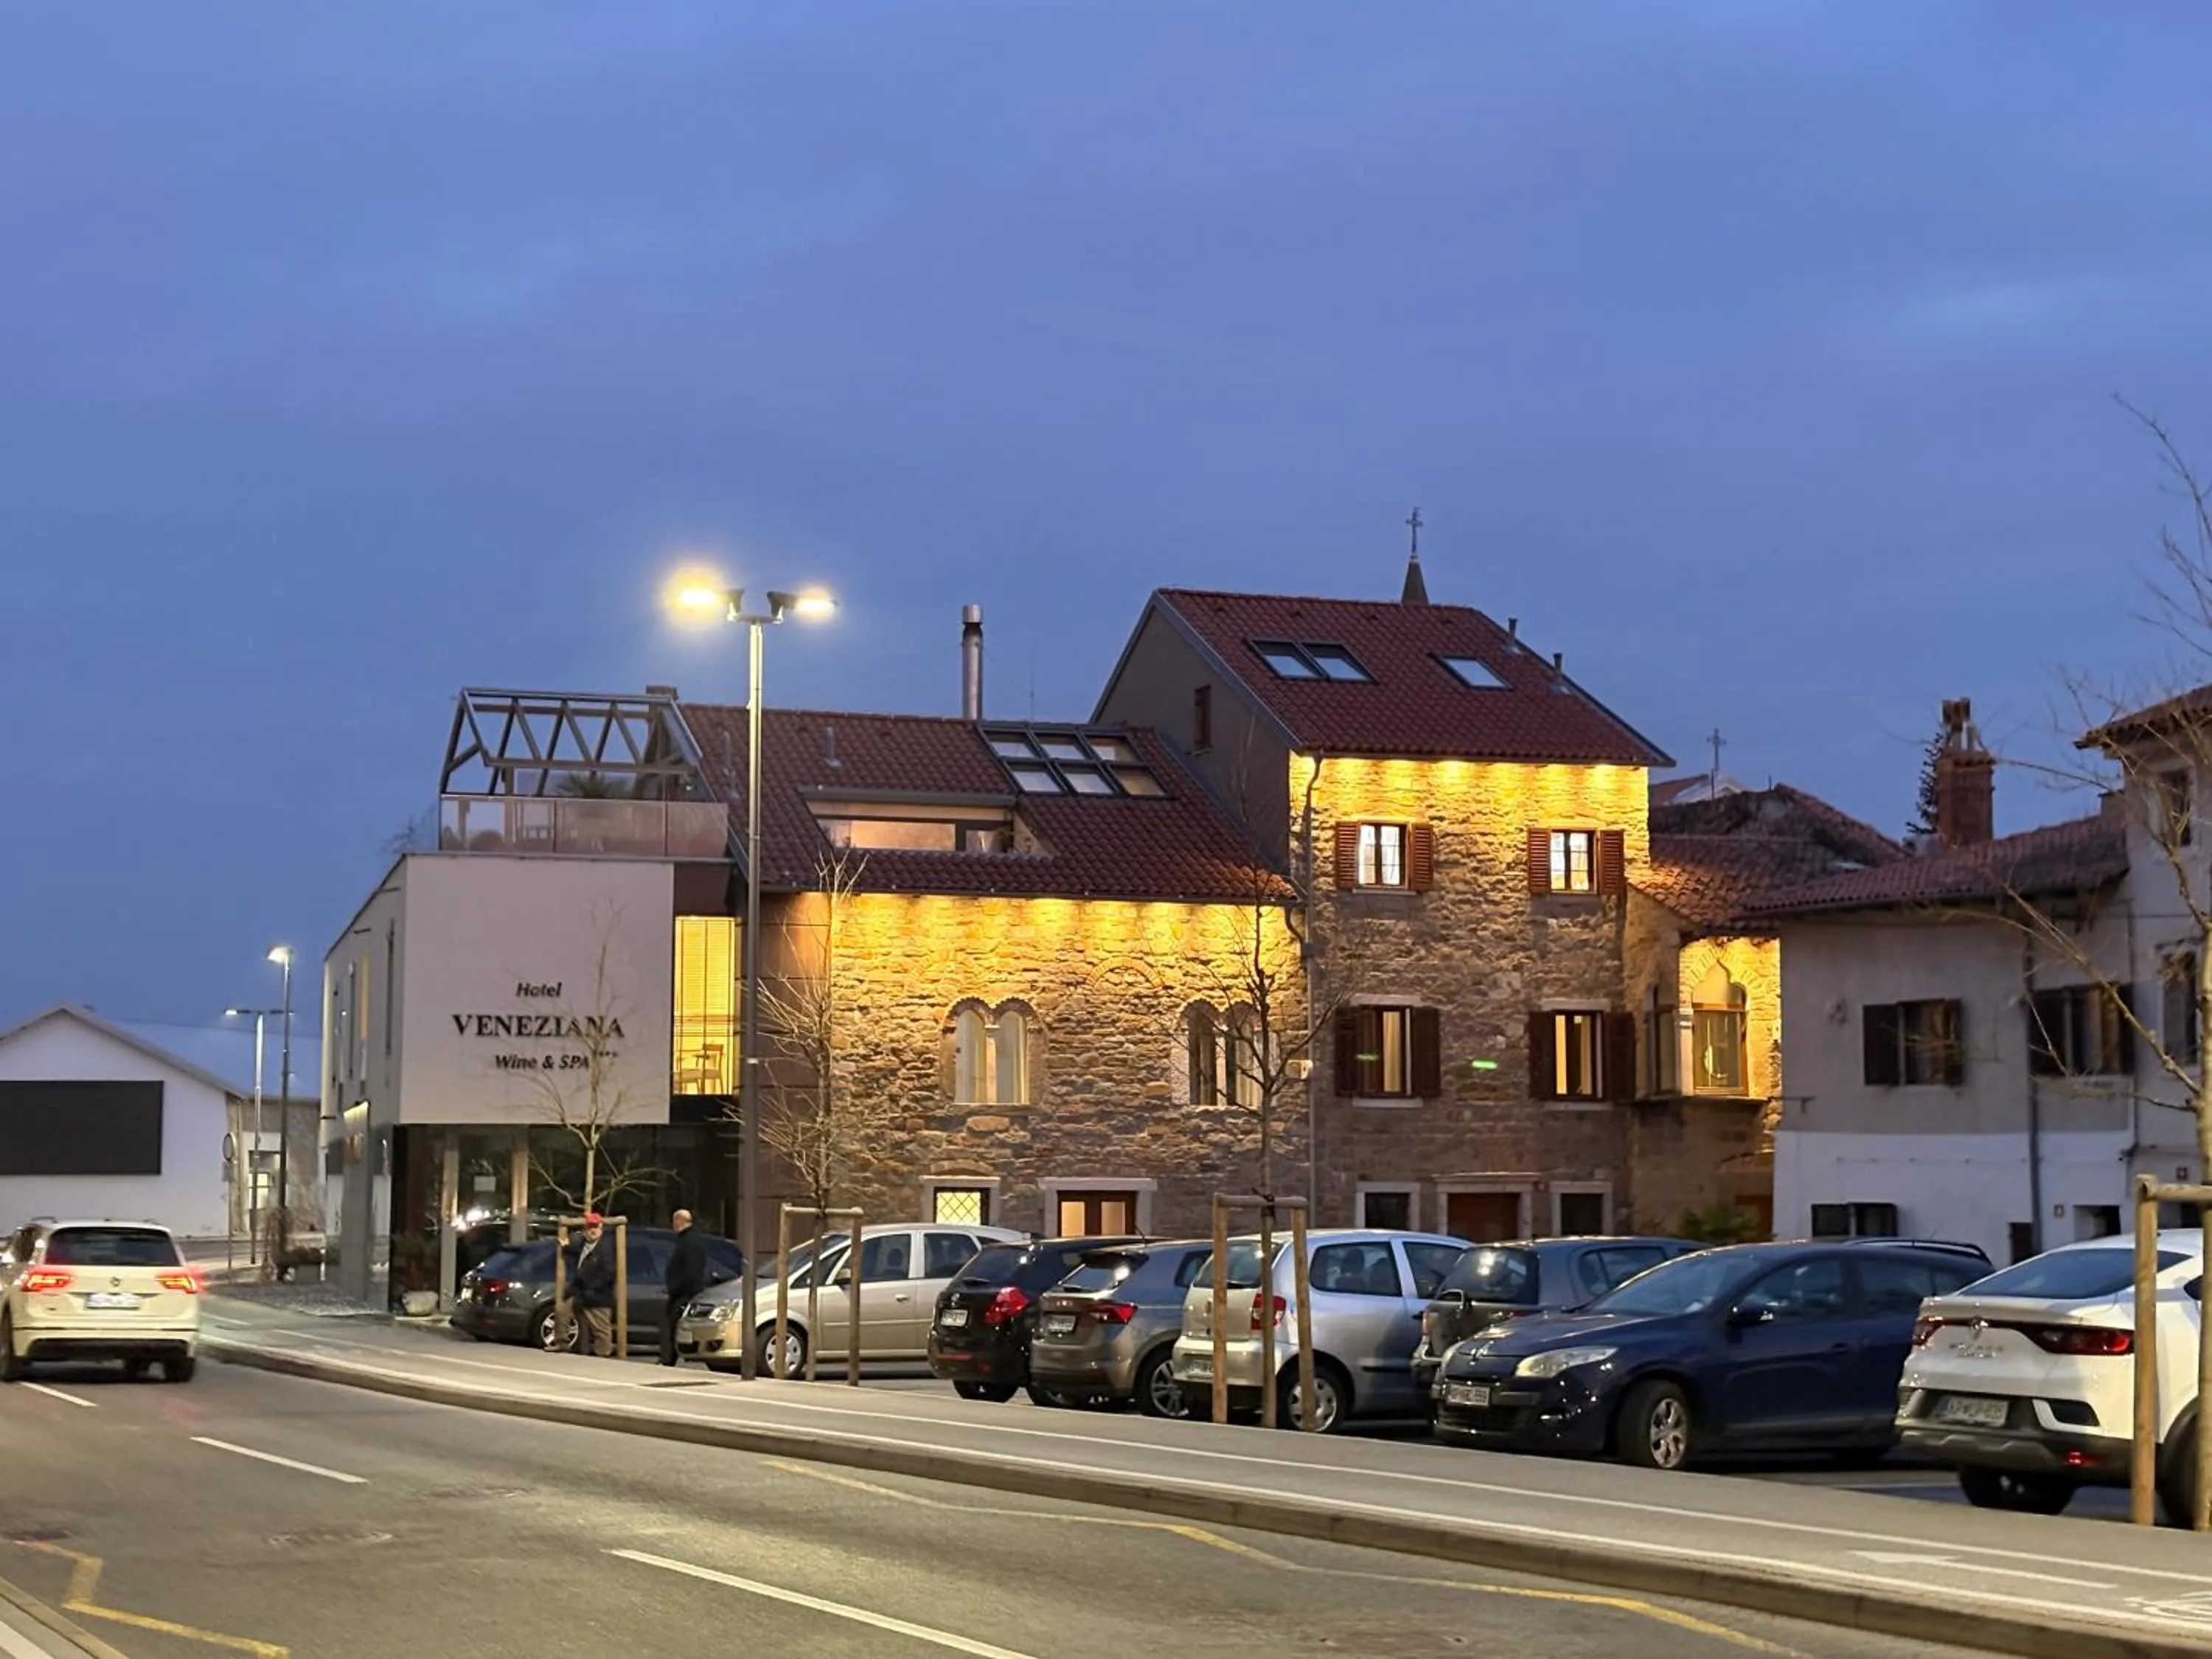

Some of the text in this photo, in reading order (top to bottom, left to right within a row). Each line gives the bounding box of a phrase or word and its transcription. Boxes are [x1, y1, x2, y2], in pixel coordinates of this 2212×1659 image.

[517, 981, 562, 997] Hotel
[452, 1014, 625, 1038] VENEZIANA
[495, 1054, 538, 1069] Wine
[542, 1054, 554, 1069] &
